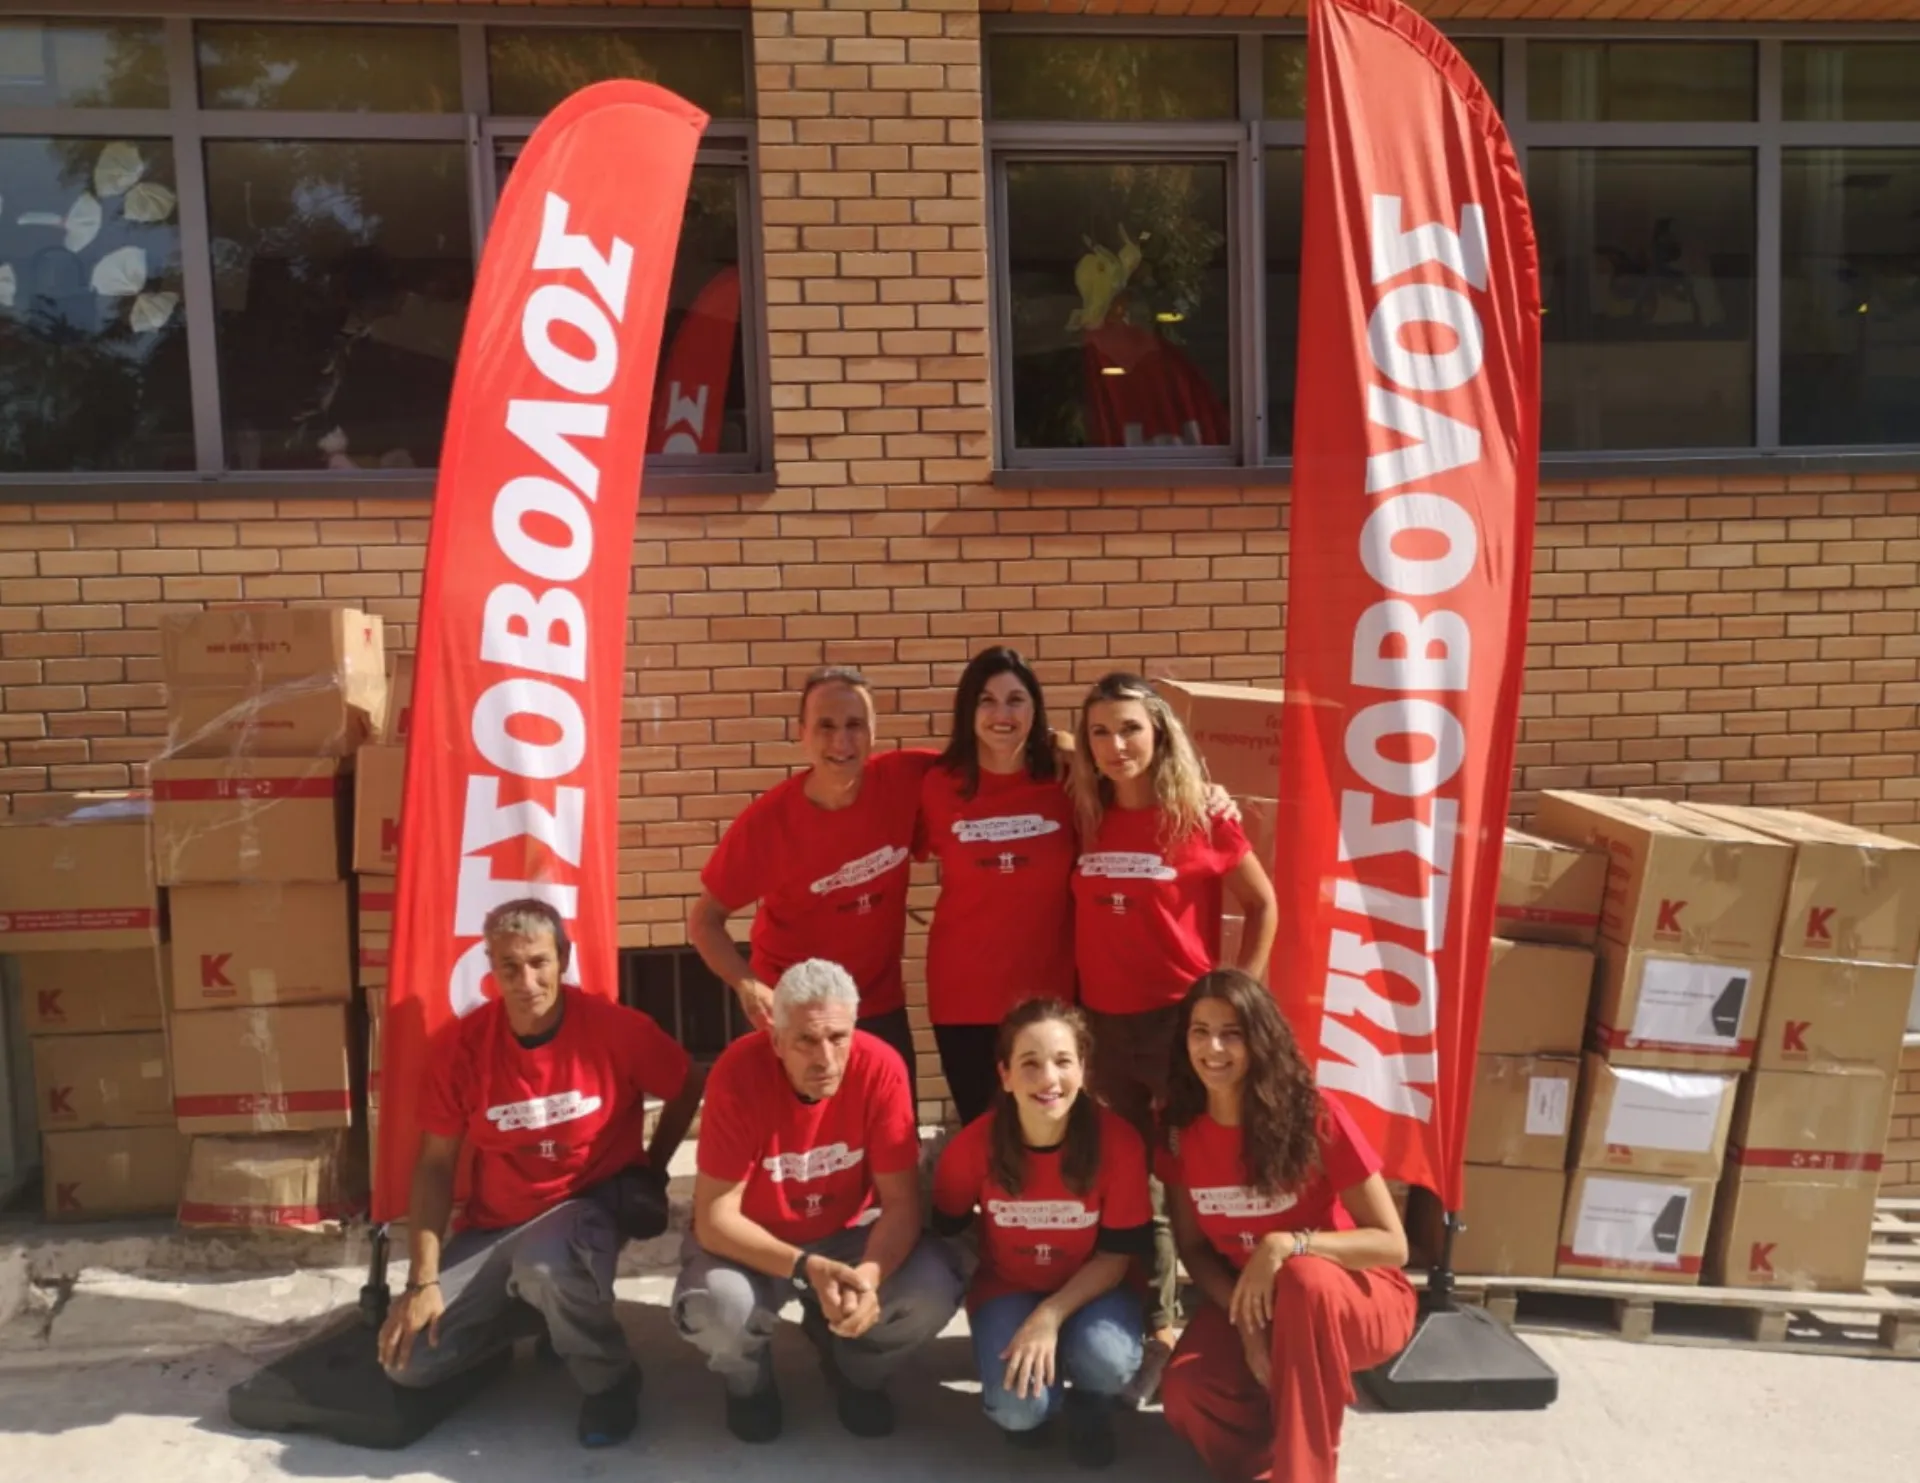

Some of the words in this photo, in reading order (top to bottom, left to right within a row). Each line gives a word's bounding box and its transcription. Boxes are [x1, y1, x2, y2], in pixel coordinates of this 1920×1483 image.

[1315, 194, 1489, 1125] ΚΩΤΣΟΒΟΛΟΣ
[1656, 898, 1689, 932] K
[1805, 906, 1837, 939] K
[200, 952, 235, 988] K
[37, 988, 66, 1017] K
[1783, 1021, 1813, 1052] K
[49, 1086, 77, 1113] K
[1749, 1241, 1779, 1272] K
